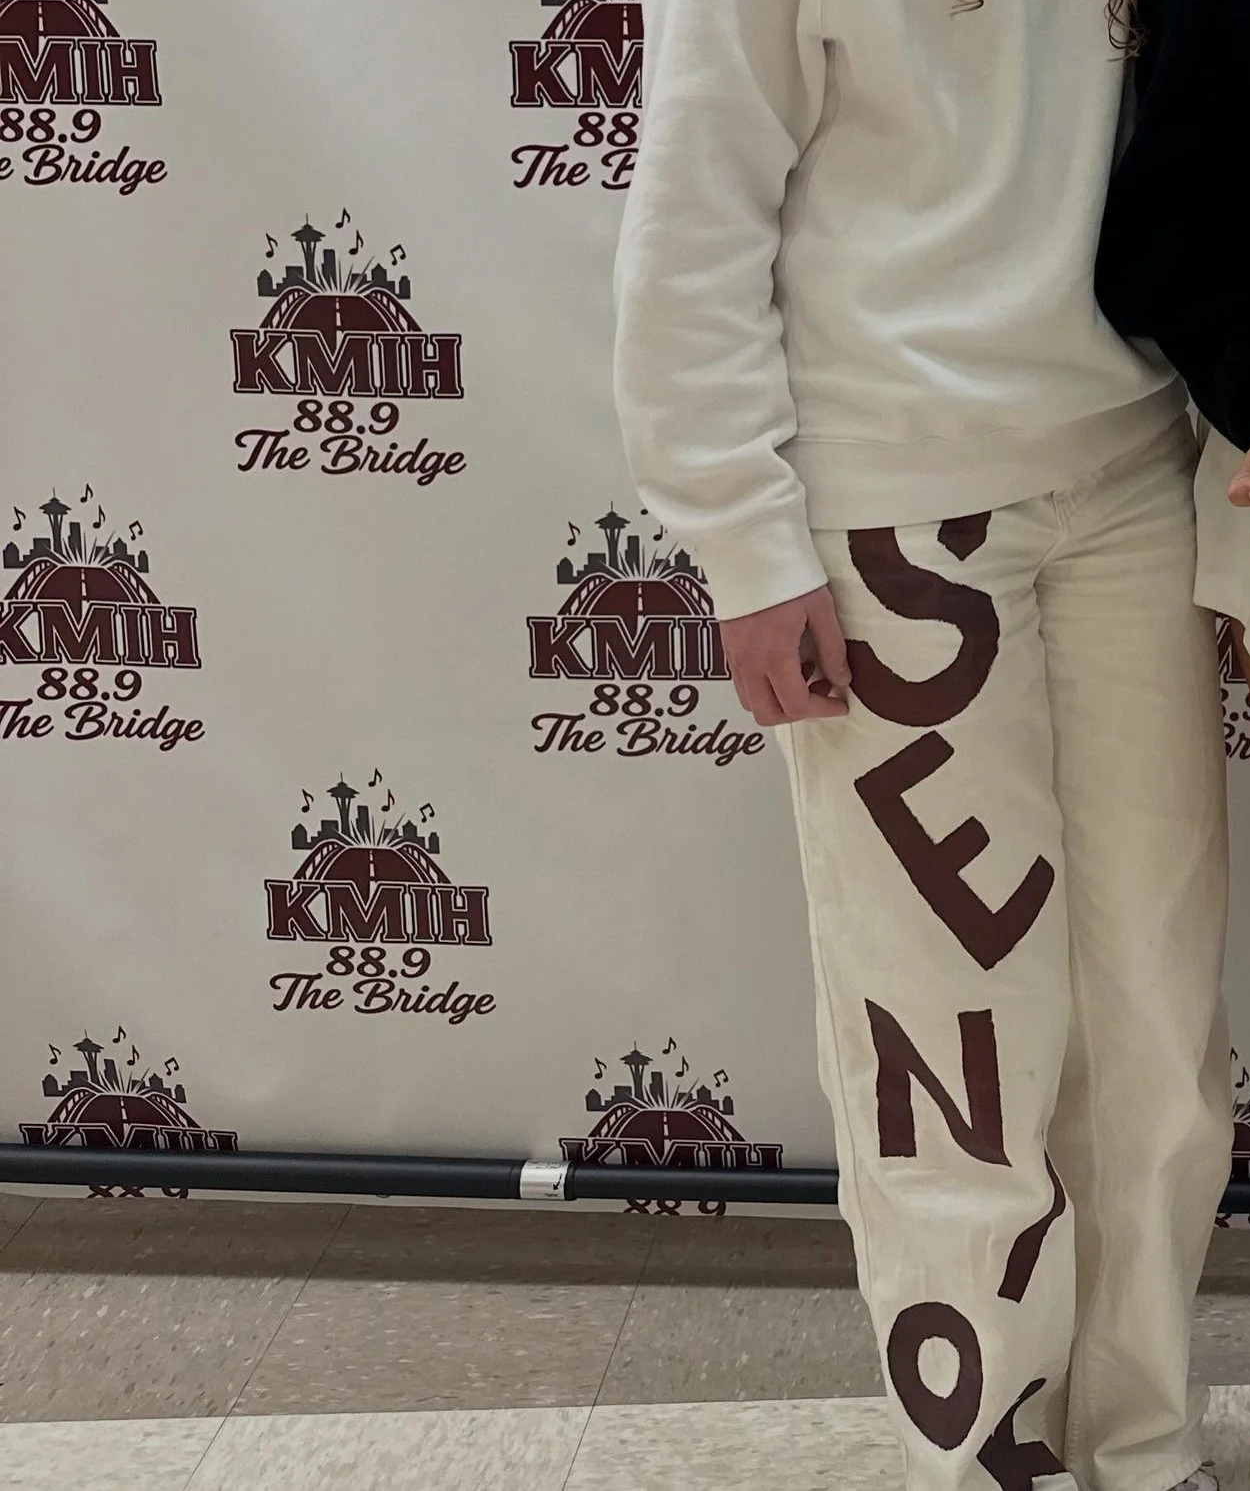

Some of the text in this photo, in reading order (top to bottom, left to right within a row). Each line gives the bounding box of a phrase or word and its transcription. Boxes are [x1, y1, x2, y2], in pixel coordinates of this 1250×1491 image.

[0, 38, 162, 106] MIH
[509, 40, 643, 109] KM
[0, 108, 101, 143] 88.9
[573, 112, 639, 147] 88
[22, 144, 167, 195] Bridge
[511, 144, 590, 188] The
[230, 331, 464, 399] KMIH
[293, 399, 399, 435] 88.9
[235, 429, 467, 486] The Bridge
[37, 667, 142, 701] 88.9
[589, 684, 699, 717] 88.9
[64, 701, 205, 751] Bridge
[531, 713, 765, 766] The Bridge
[264, 883, 493, 946] KMIH
[326, 946, 431, 978] 88.9
[270, 973, 496, 1025] The Bridge
